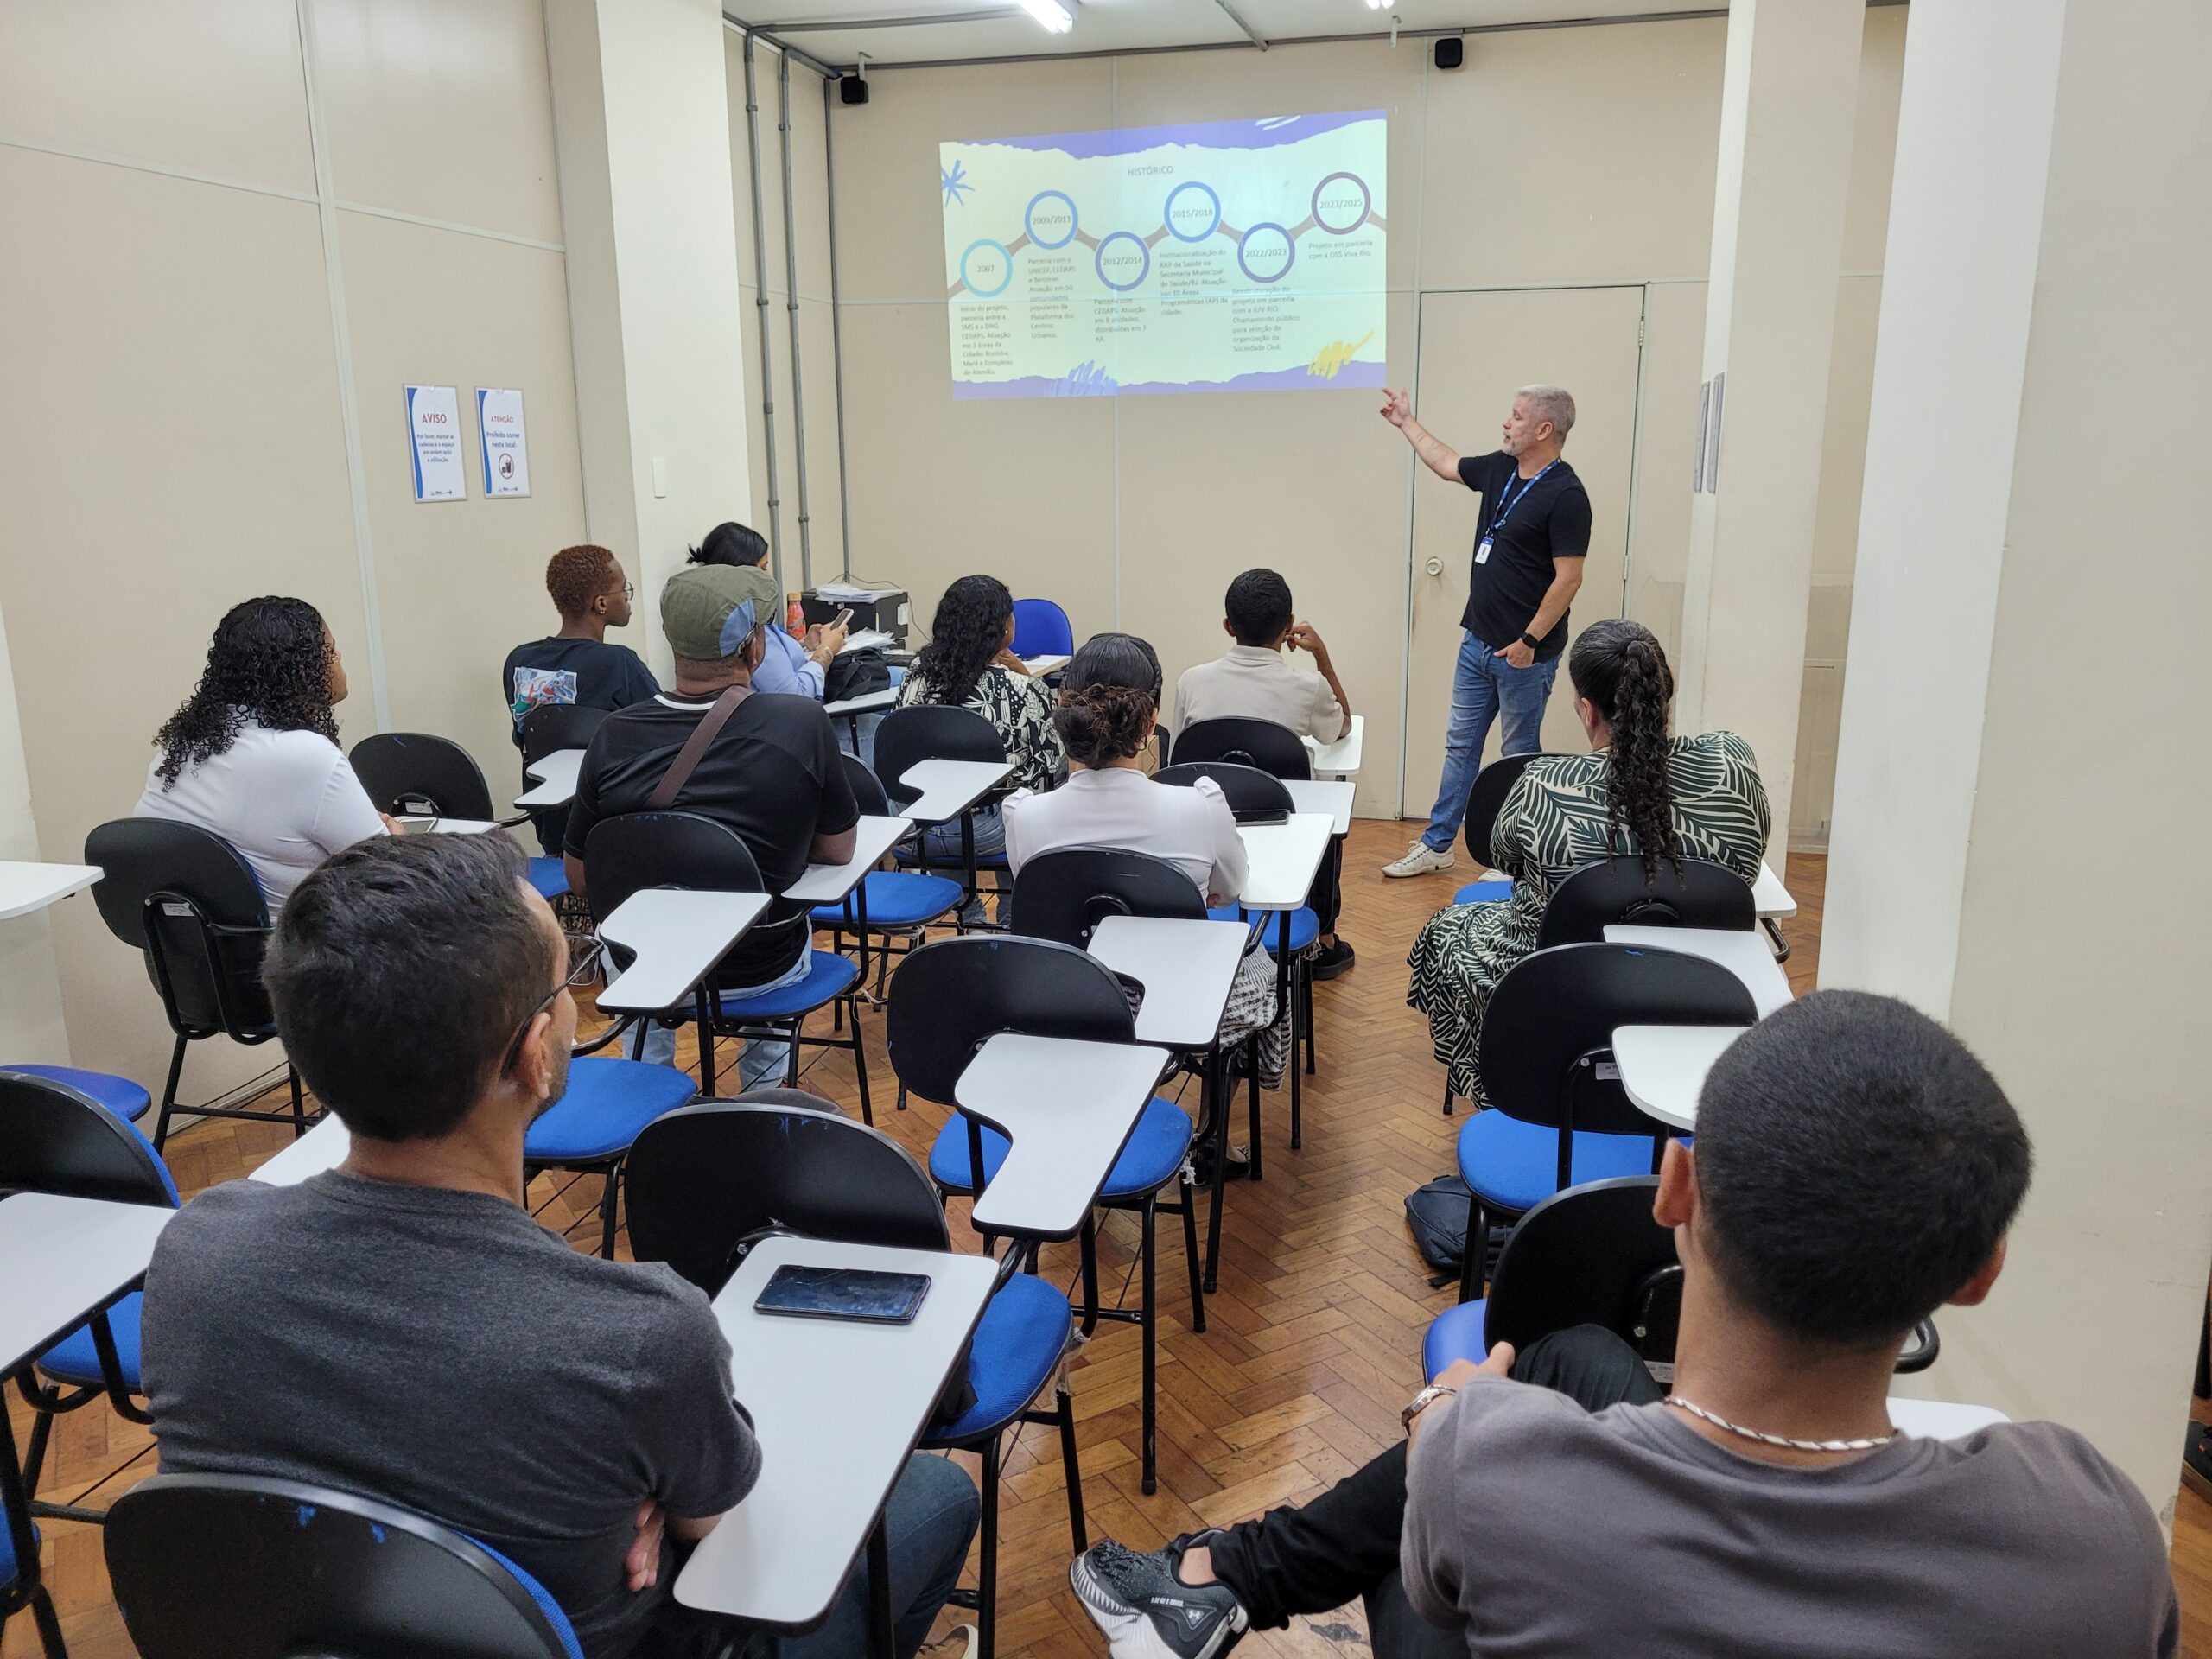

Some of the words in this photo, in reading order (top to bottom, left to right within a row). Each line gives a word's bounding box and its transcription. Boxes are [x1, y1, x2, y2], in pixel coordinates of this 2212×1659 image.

[1128, 165, 1174, 176] HISTÓRICO
[1319, 199, 1363, 209] 2023/2025
[1172, 208, 1213, 219] 2015/2018
[1033, 215, 1071, 226] 2009/2011
[1245, 248, 1287, 258] 2022/2023
[1103, 257, 1142, 266] 2012/2014
[977, 264, 995, 273] 2007
[422, 413, 447, 424] AVISO
[491, 415, 514, 424] ATENÇÃO
